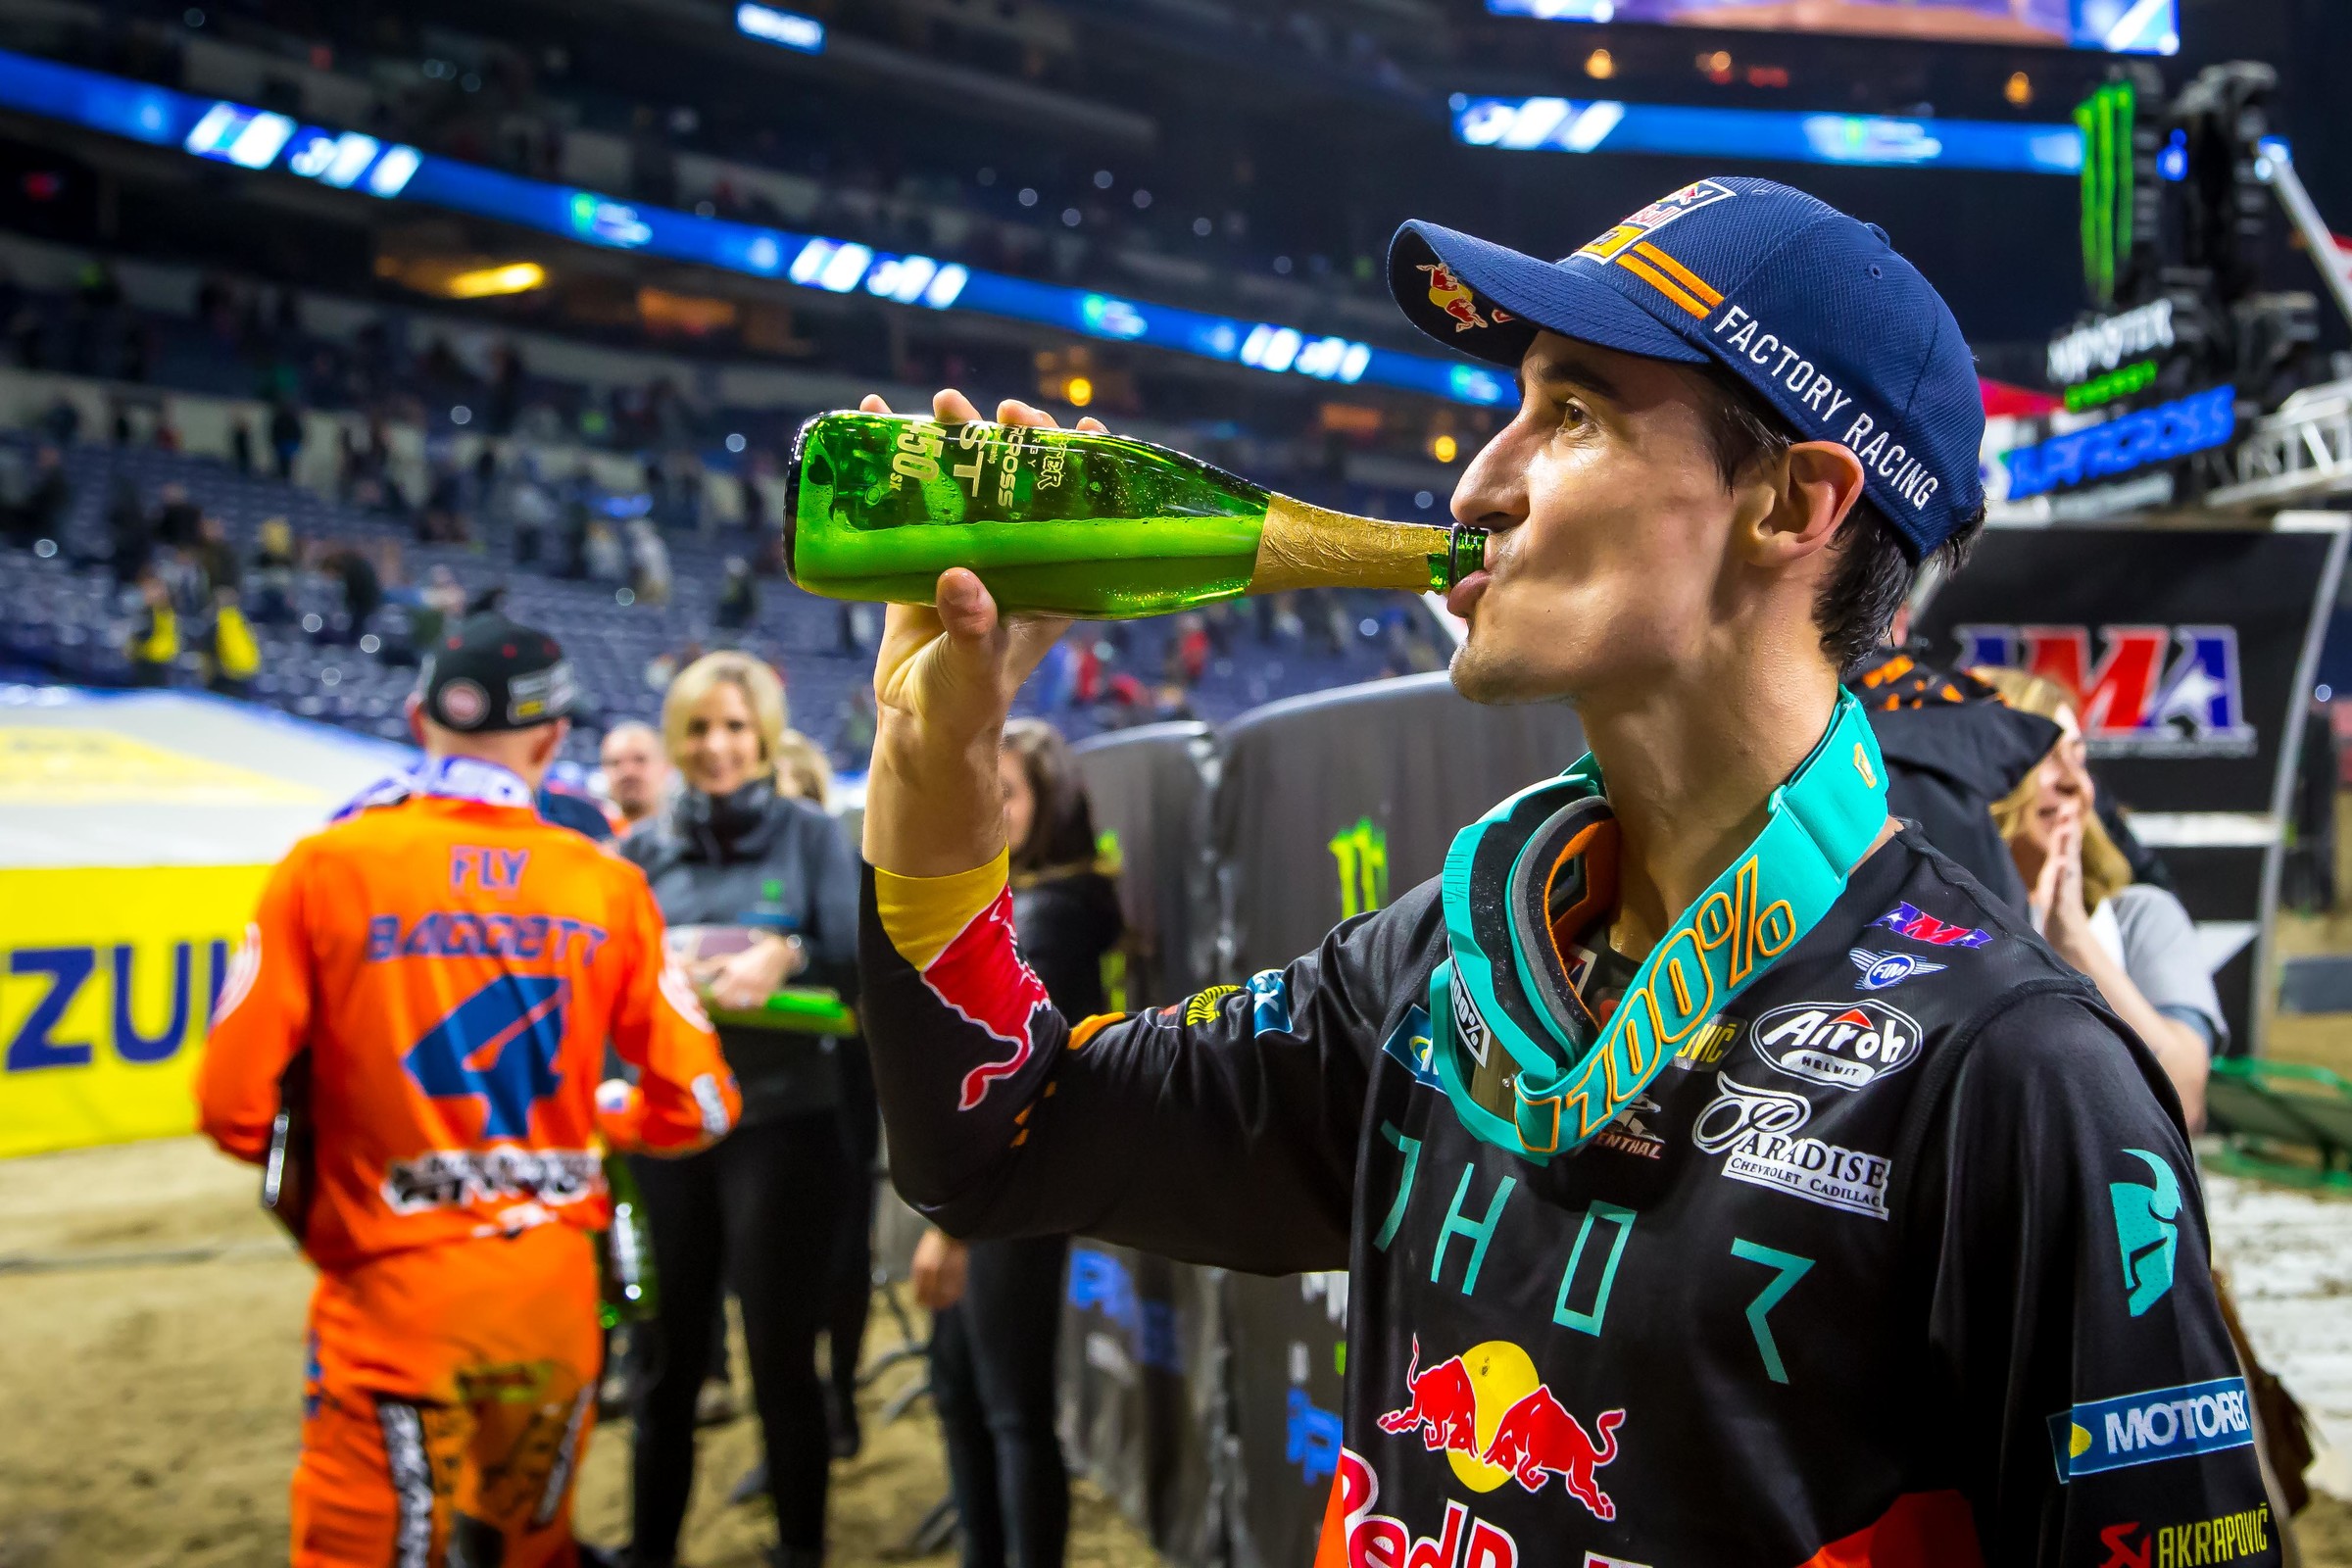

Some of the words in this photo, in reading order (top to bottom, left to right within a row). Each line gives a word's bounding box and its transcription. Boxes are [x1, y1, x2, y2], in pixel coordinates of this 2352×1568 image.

[1713, 305, 1852, 422] FACTORY
[1842, 413, 1939, 511] RACING
[450, 846, 529, 890] FLY
[366, 911, 610, 967] BAGGETT
[1864, 901, 1994, 949] AMA
[1566, 855, 1797, 1139] 100%
[1872, 962, 1909, 979] FIM
[398, 973, 572, 1141] 4
[1762, 1009, 1906, 1064] Airoh
[1592, 1133, 1664, 1160] ENTHAL
[1692, 1071, 1888, 1189] PARADISE
[1730, 1156, 1802, 1186] CHEVROLET
[1809, 1178, 1882, 1208] CADILLAC
[2105, 1390, 2251, 1454] MOTOREX
